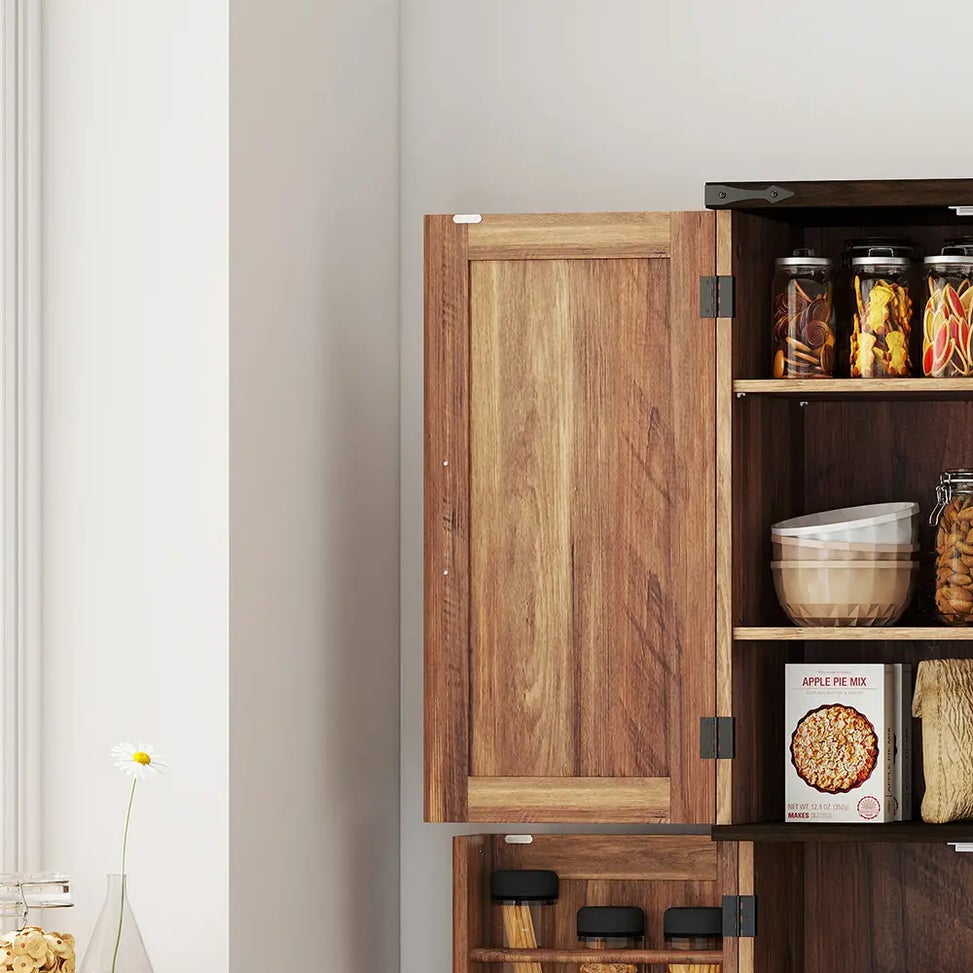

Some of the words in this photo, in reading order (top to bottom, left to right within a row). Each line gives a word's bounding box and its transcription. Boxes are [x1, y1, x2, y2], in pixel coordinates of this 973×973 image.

[802, 677, 831, 687] APPLE
[833, 677, 847, 687] PIE
[850, 677, 867, 687] MIX
